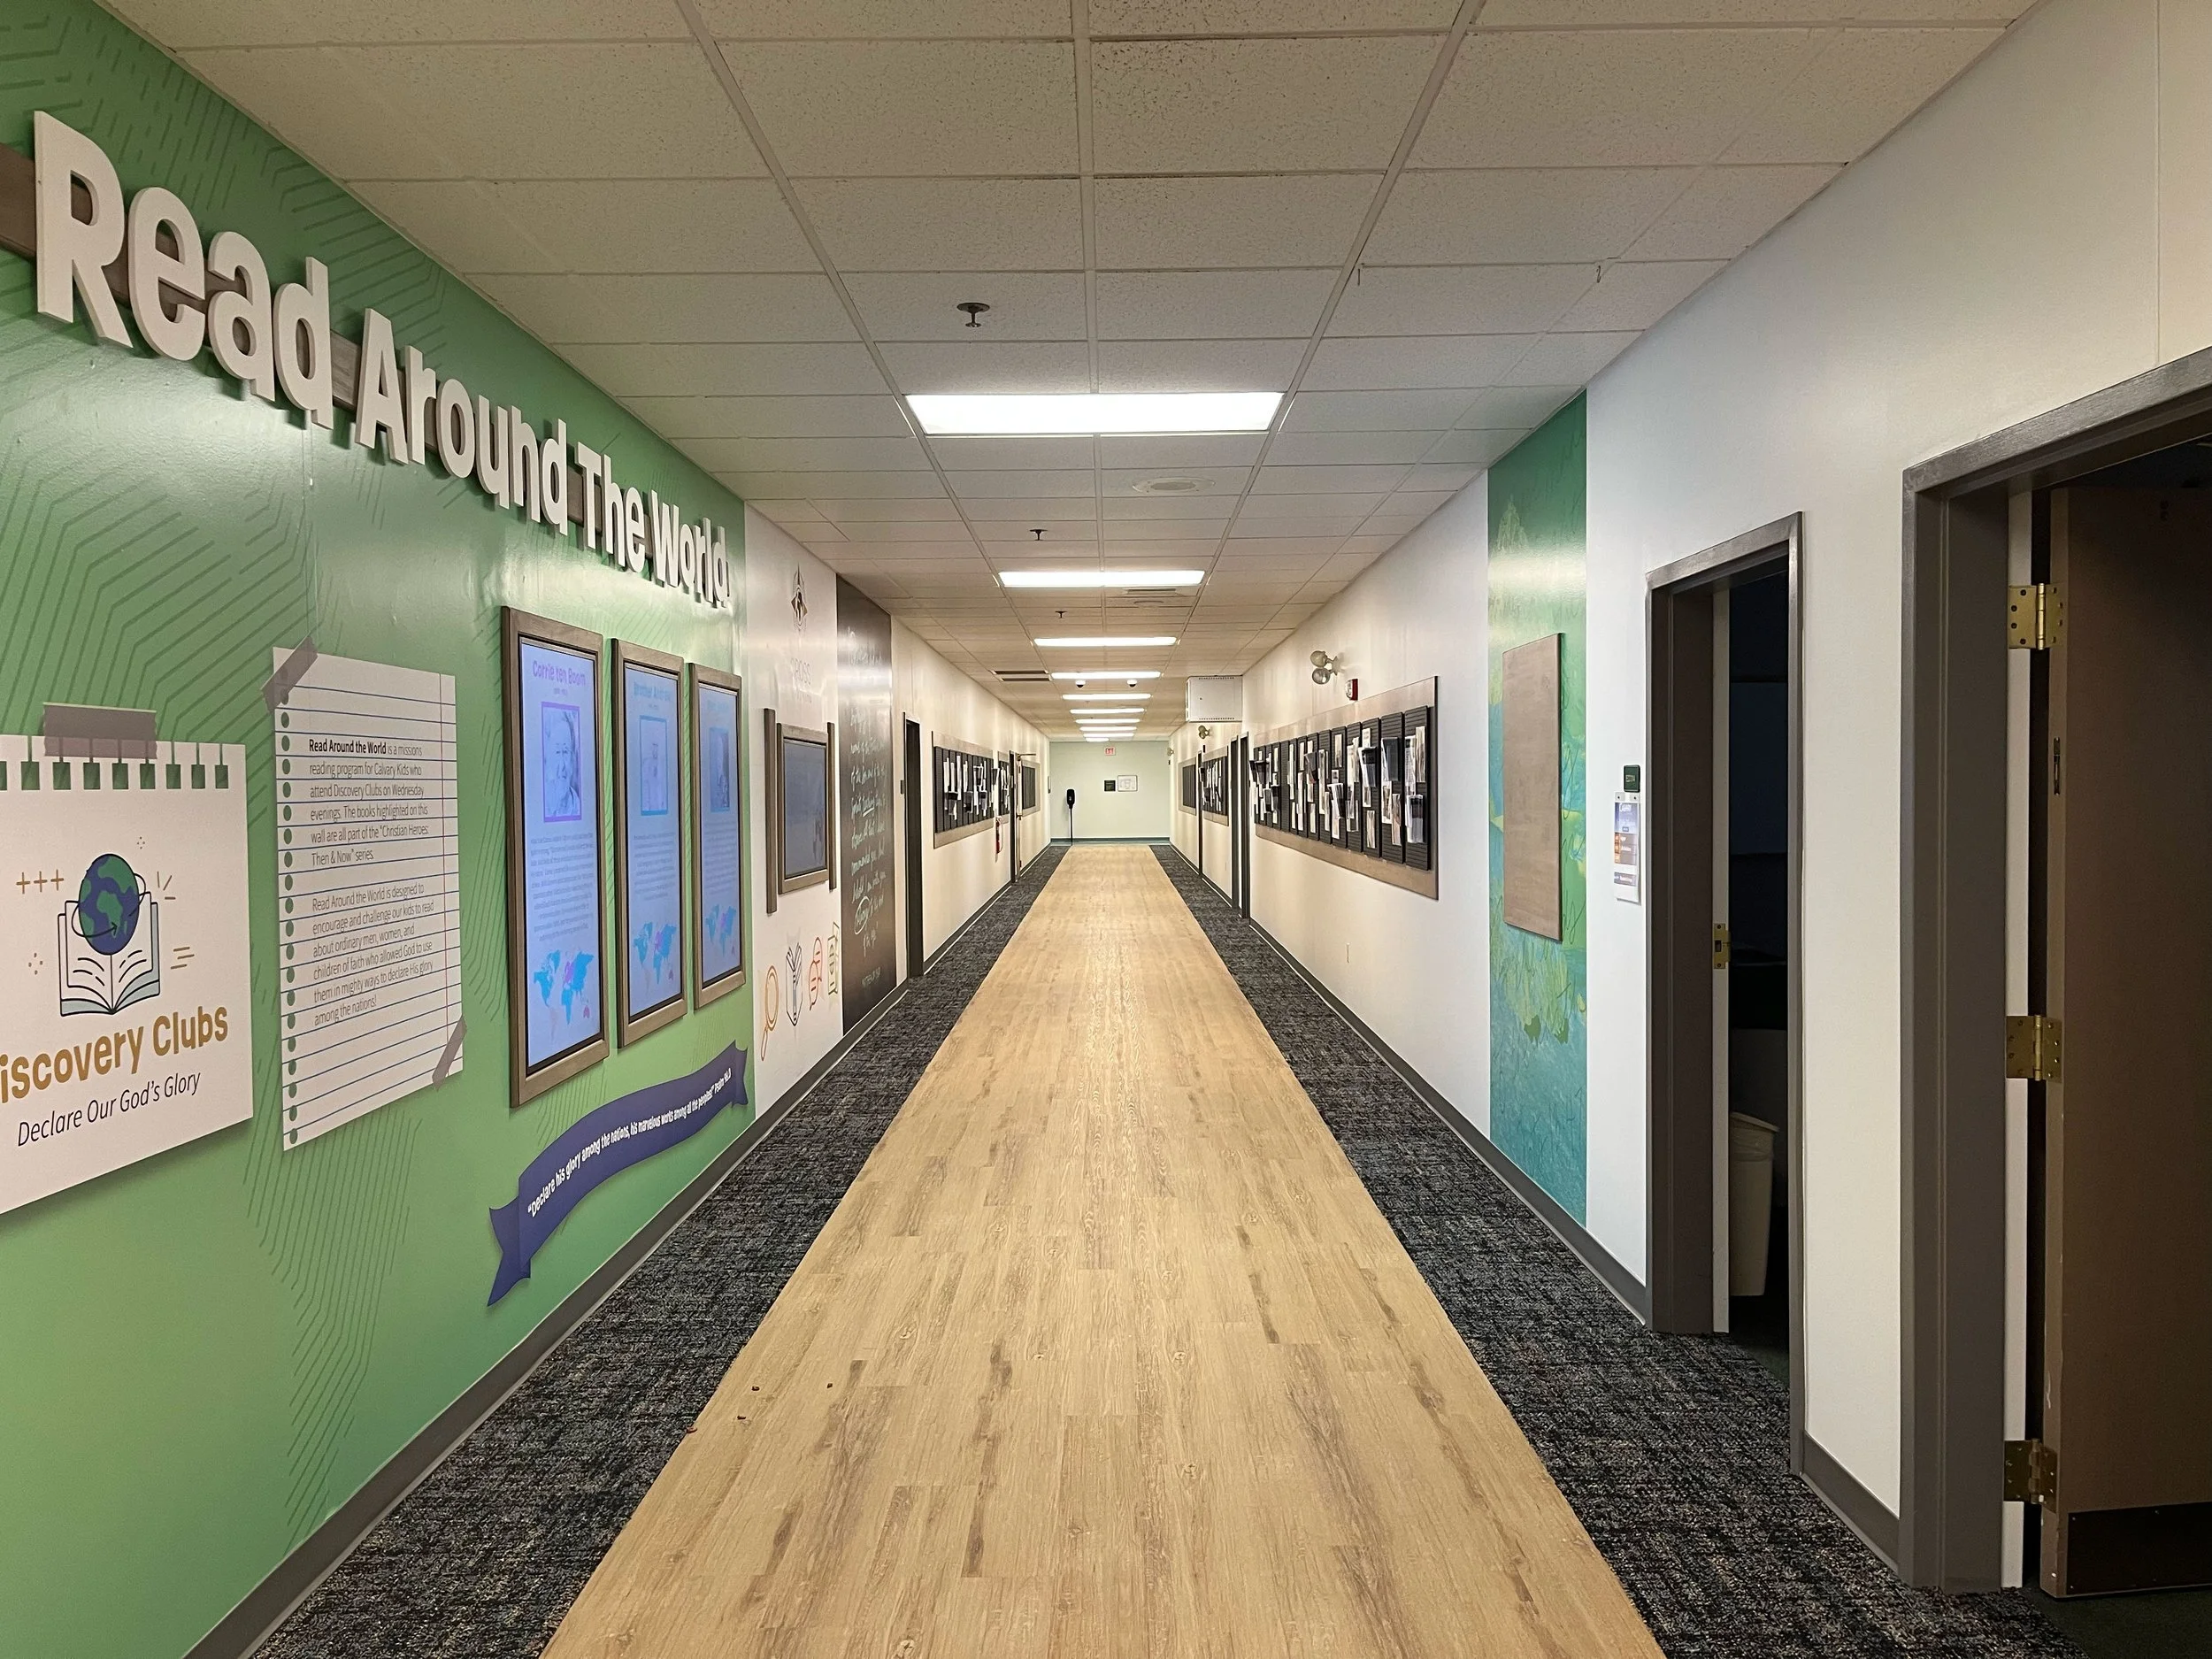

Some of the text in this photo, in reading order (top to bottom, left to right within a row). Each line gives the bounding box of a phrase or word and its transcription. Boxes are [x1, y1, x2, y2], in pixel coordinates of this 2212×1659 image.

[35, 110, 728, 605] Read Around The World
[309, 739, 422, 757] Read Around the World is a missions
[310, 761, 334, 779] reading
[337, 764, 364, 779] program
[374, 763, 396, 779] Calvary
[397, 764, 409, 775] Kids
[410, 765, 422, 776] who
[311, 784, 424, 800] attend Discovery Clubs on Wednesday
[344, 805, 356, 818] The
[357, 805, 375, 818] books
[376, 803, 408, 821] highlighted
[410, 805, 417, 815] on
[418, 803, 427, 815] this
[311, 828, 325, 844] wall
[326, 831, 337, 842] are
[348, 827, 360, 845] part
[362, 827, 368, 839] of
[369, 827, 379, 838] the
[312, 852, 329, 866] Then
[331, 851, 335, 863] &
[312, 883, 424, 911] Read Around the World is designed to
[313, 902, 434, 934] encourage and challenge our kids to read
[313, 942, 334, 957] about
[335, 936, 363, 952] ordinary
[404, 925, 414, 937] and
[314, 942, 432, 980] children of faith who allowed God to use
[314, 961, 434, 1002] them in mighty ways to declare His glory
[315, 1009, 339, 1025] among
[340, 1002, 350, 1017] the
[0, 1005, 228, 1104] iscovery Clubs
[18, 1071, 201, 1147] Declare Our God's Glory
[556, 1169, 565, 1187] his
[565, 1152, 580, 1179] glory
[581, 1139, 601, 1162] among
[601, 1133, 611, 1148] the
[638, 1115, 661, 1133] marvelous
[661, 1110, 673, 1125] works
[674, 1105, 687, 1120] among
